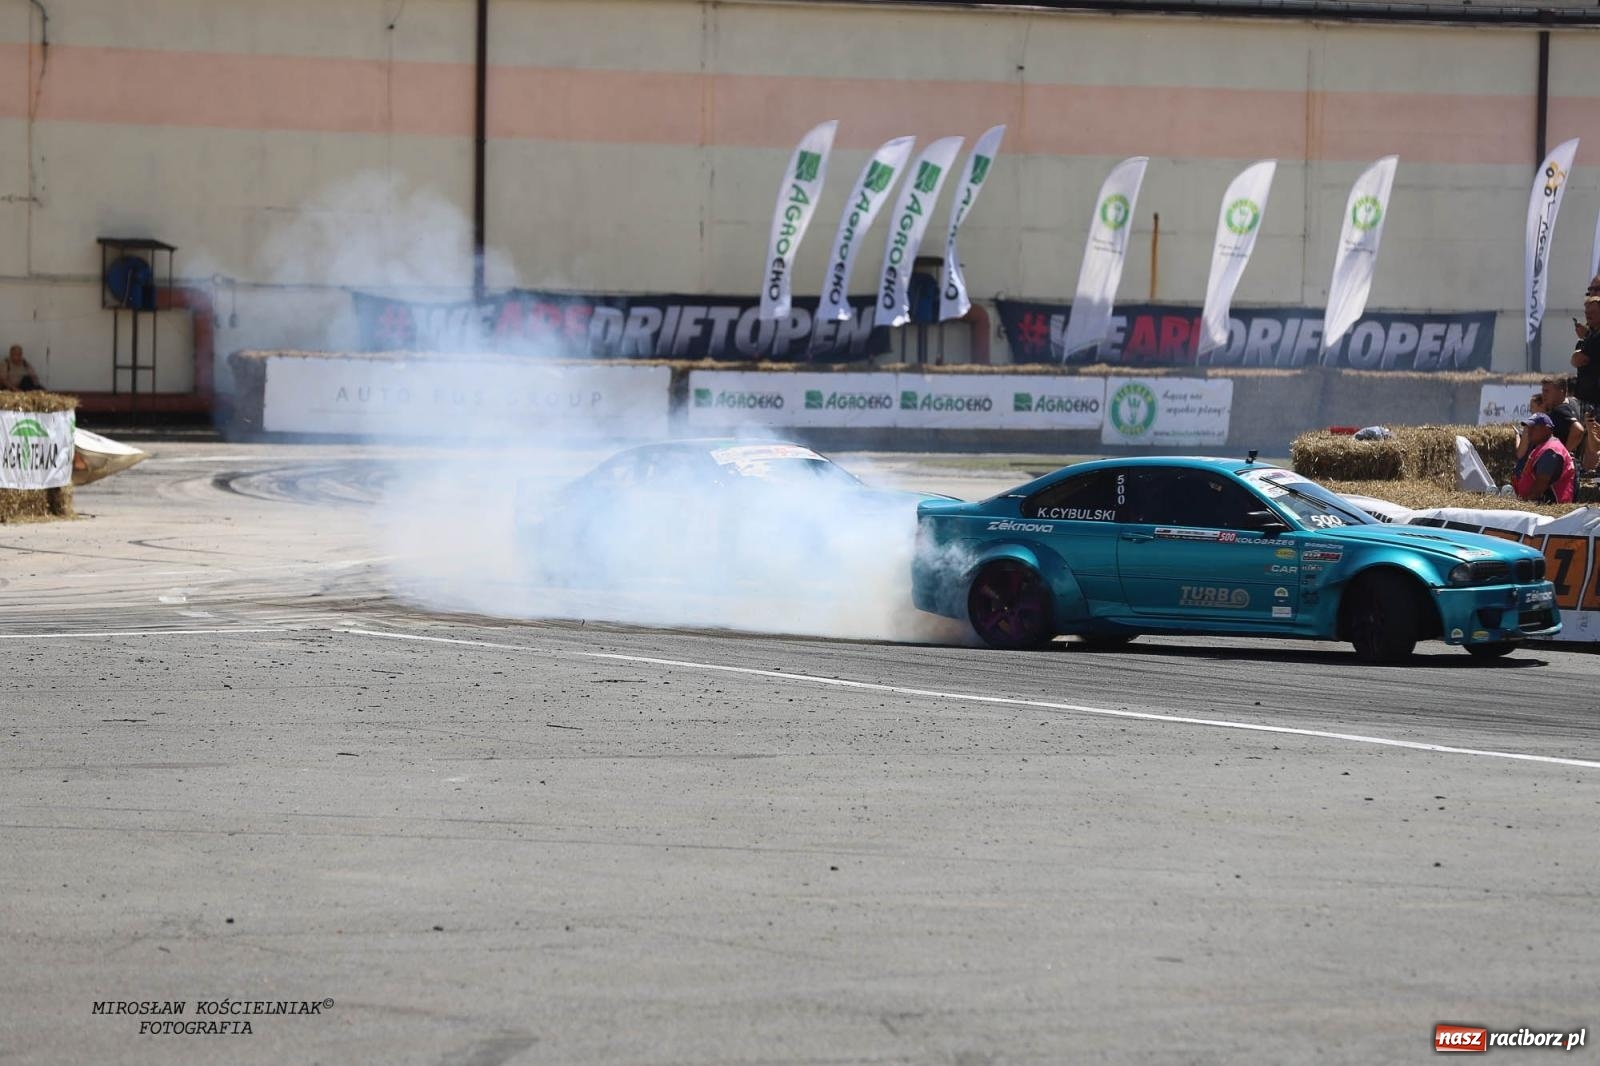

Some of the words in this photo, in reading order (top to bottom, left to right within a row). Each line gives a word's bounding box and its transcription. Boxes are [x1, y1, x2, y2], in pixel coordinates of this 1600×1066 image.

[715, 391, 785, 410] AGROEKO
[825, 391, 894, 410] AGROEKO
[919, 393, 993, 412] AGROEKO
[1034, 394, 1100, 413] AGROEKO
[1116, 474, 1126, 505] 500
[1036, 507, 1117, 521] K.CYBULSKI
[1310, 514, 1343, 527] 500
[1217, 532, 1237, 543] 500
